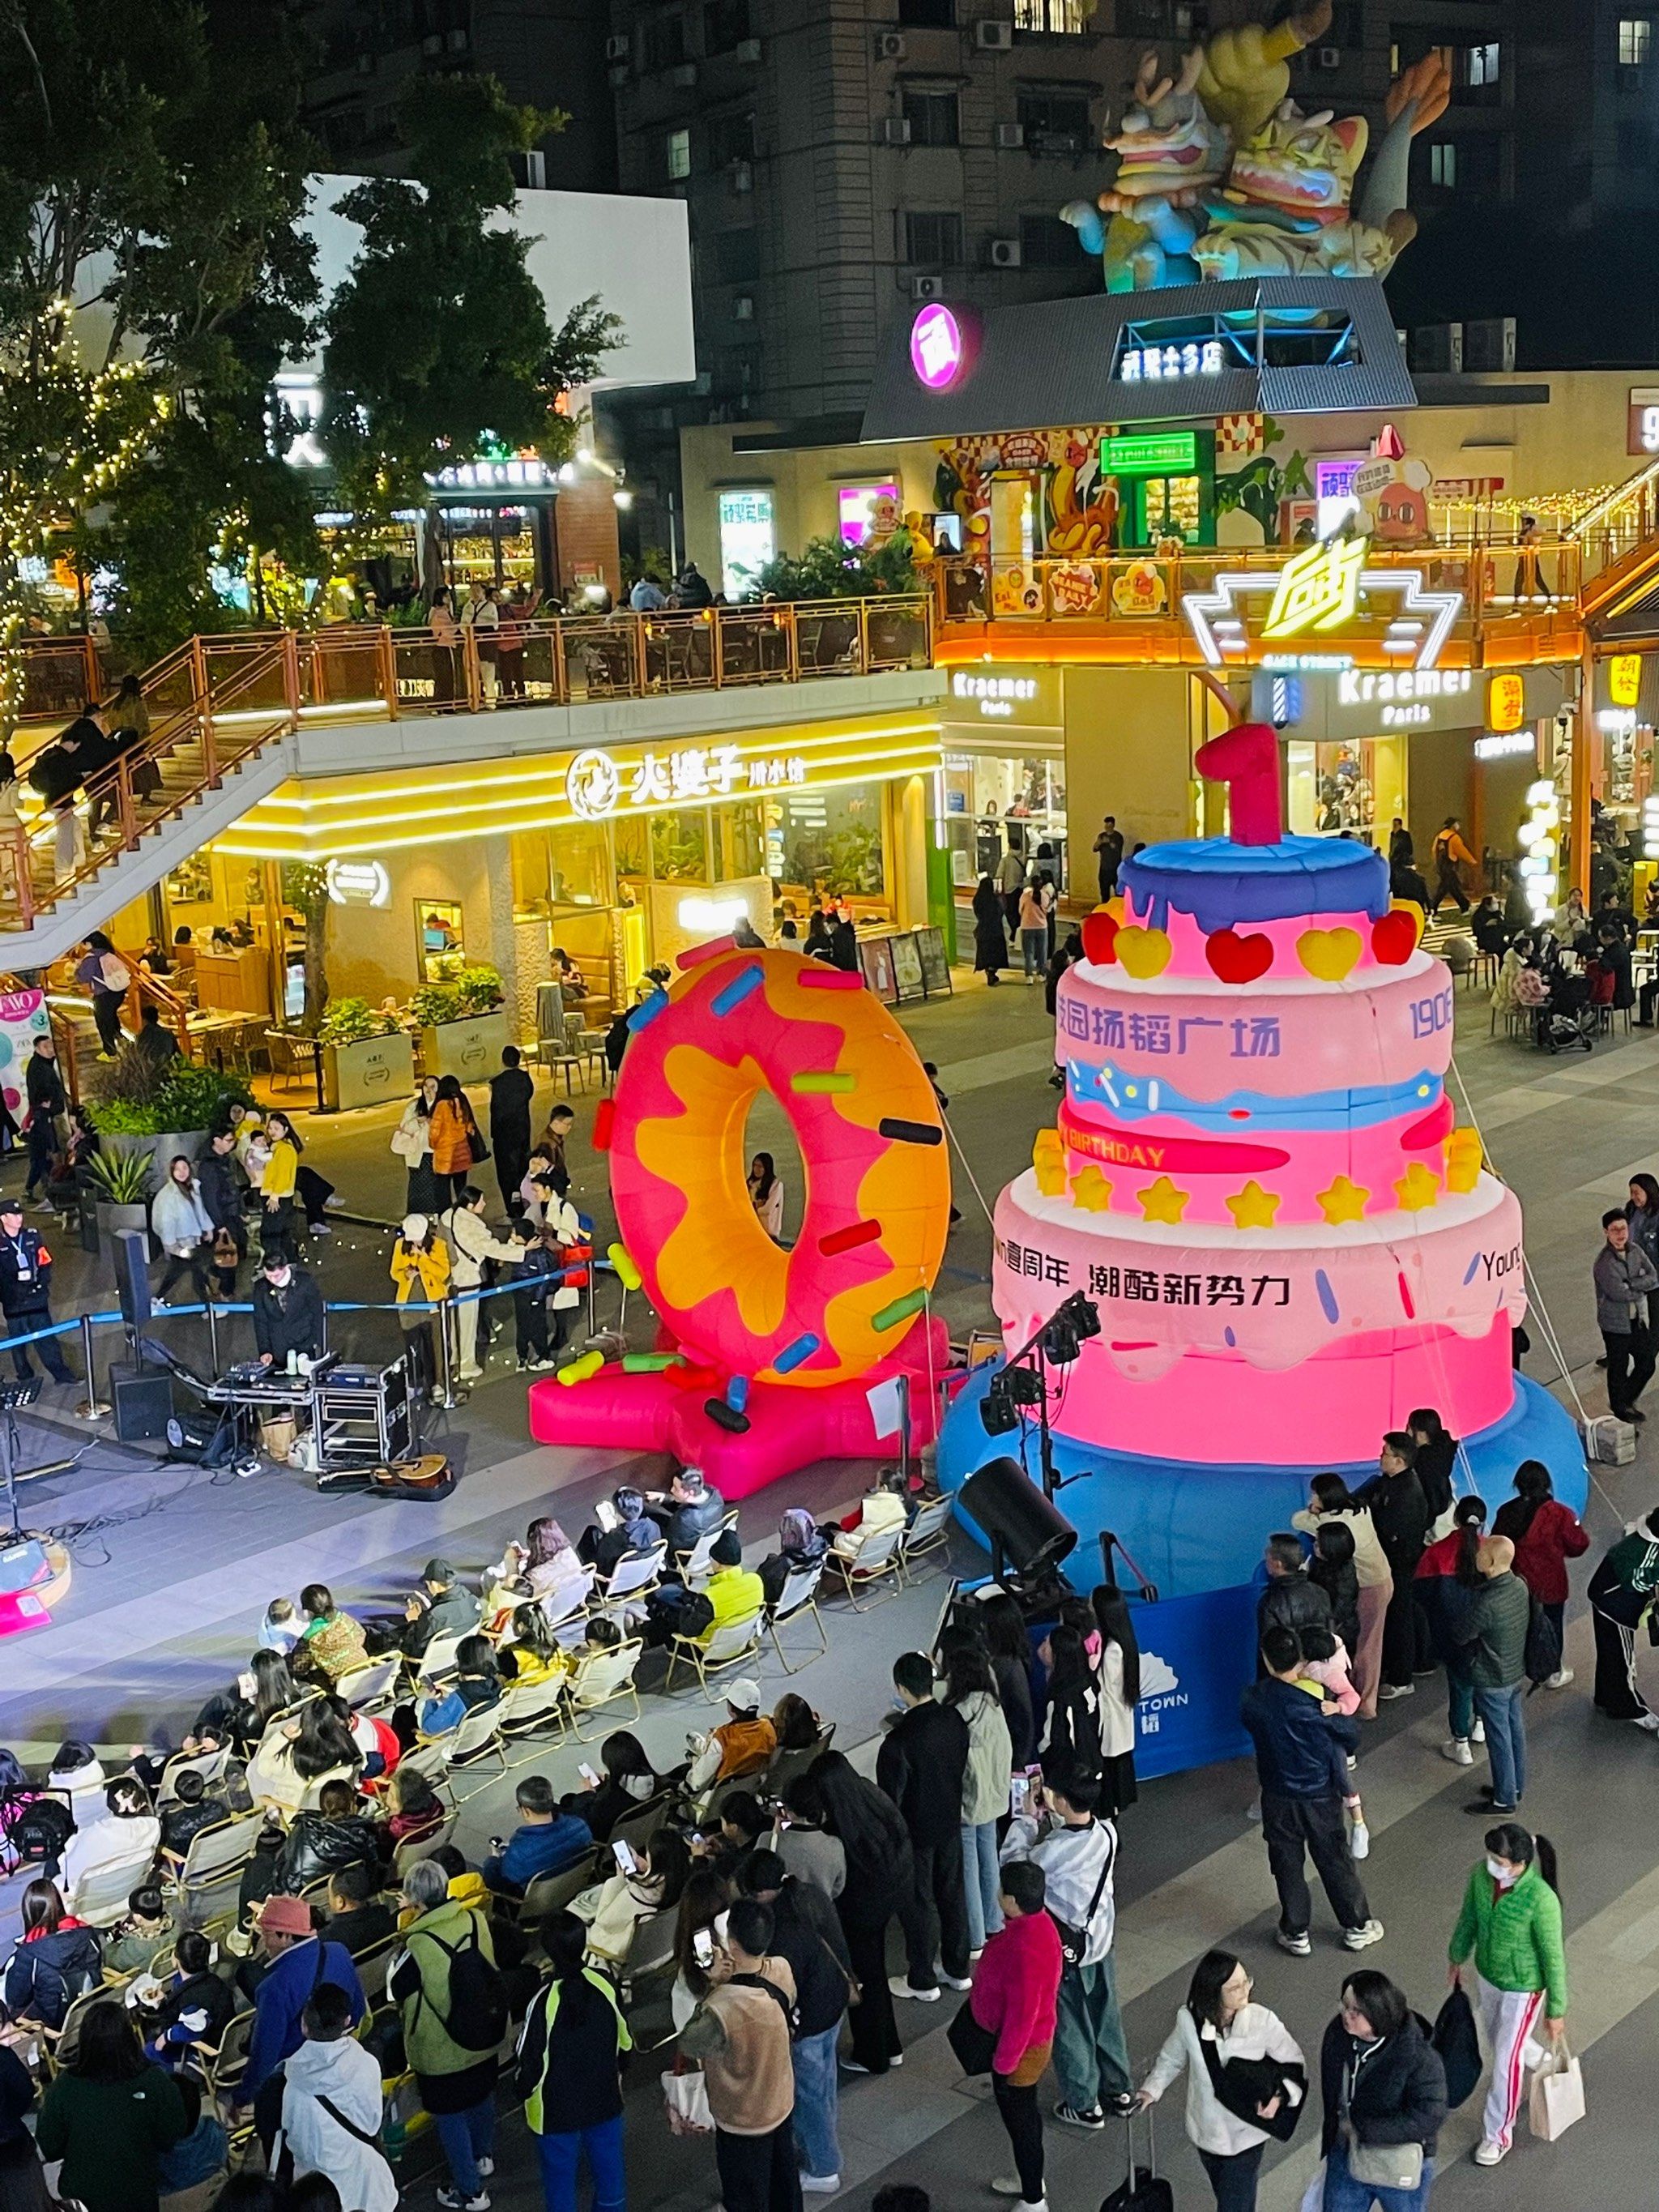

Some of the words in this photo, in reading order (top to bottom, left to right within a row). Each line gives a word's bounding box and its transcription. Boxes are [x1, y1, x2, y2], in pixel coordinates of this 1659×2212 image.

[953, 672, 1038, 698] Kraemer
[1339, 668, 1471, 705] Kraemer
[1382, 703, 1431, 726] Paris
[1069, 1127, 1166, 1168] BIRTHDAY
[1089, 1264, 1290, 1306] 潮酷新势力
[1138, 1693, 1188, 1714] TOWN
